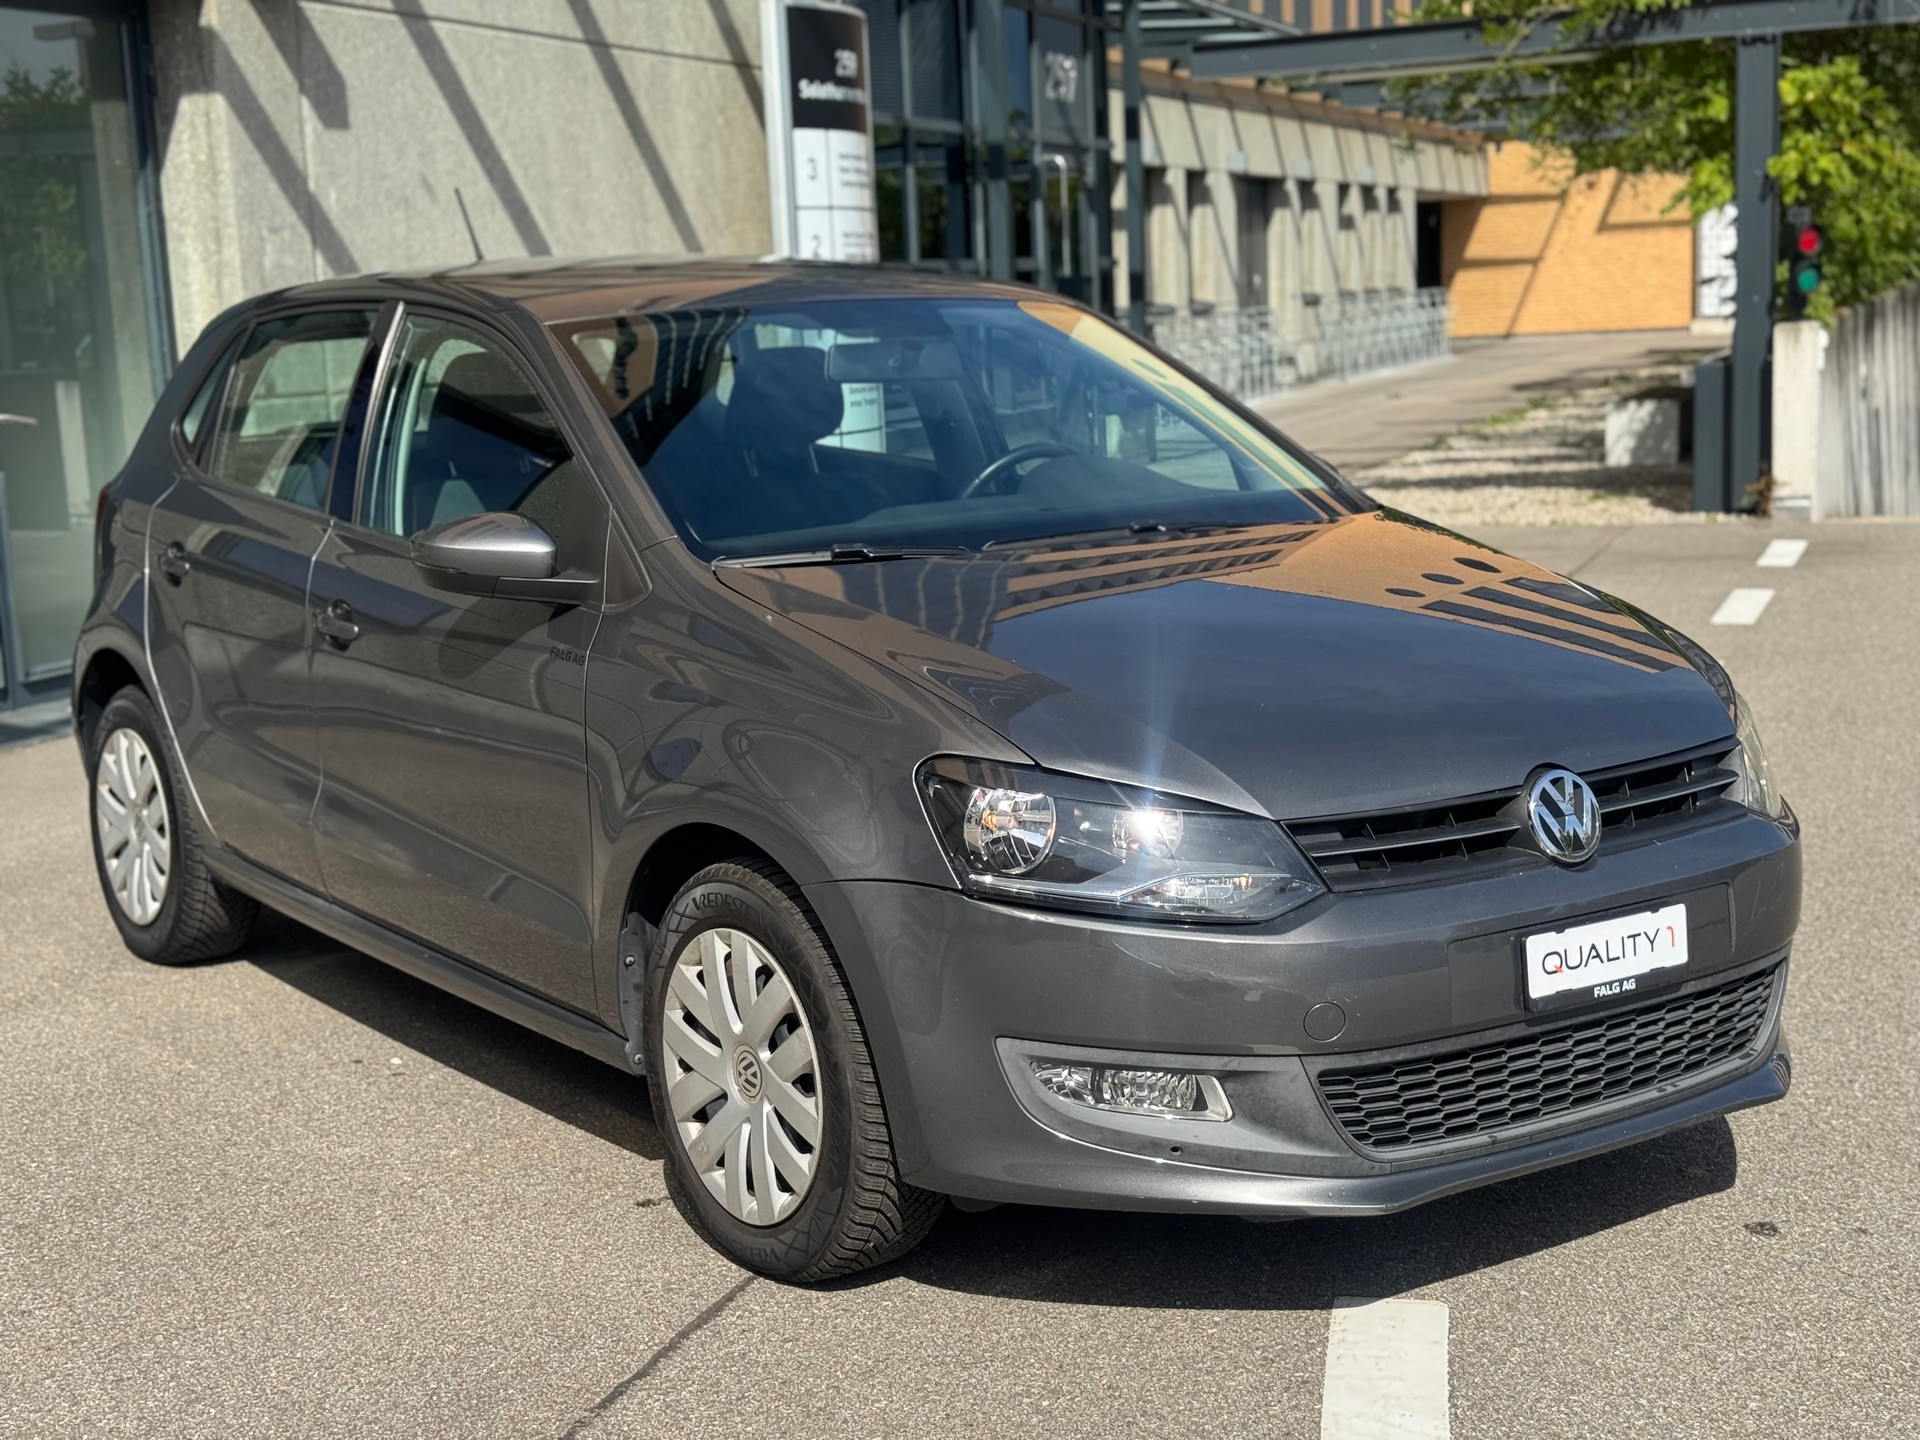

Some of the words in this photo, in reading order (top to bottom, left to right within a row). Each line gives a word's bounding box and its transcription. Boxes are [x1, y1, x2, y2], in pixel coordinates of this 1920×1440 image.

[550, 646, 573, 661] FALG
[572, 654, 586, 666] AG
[1541, 927, 1660, 976] QUALITY
[1666, 925, 1676, 948] 1
[1593, 982, 1621, 999] FALG
[1621, 979, 1636, 992] AG
